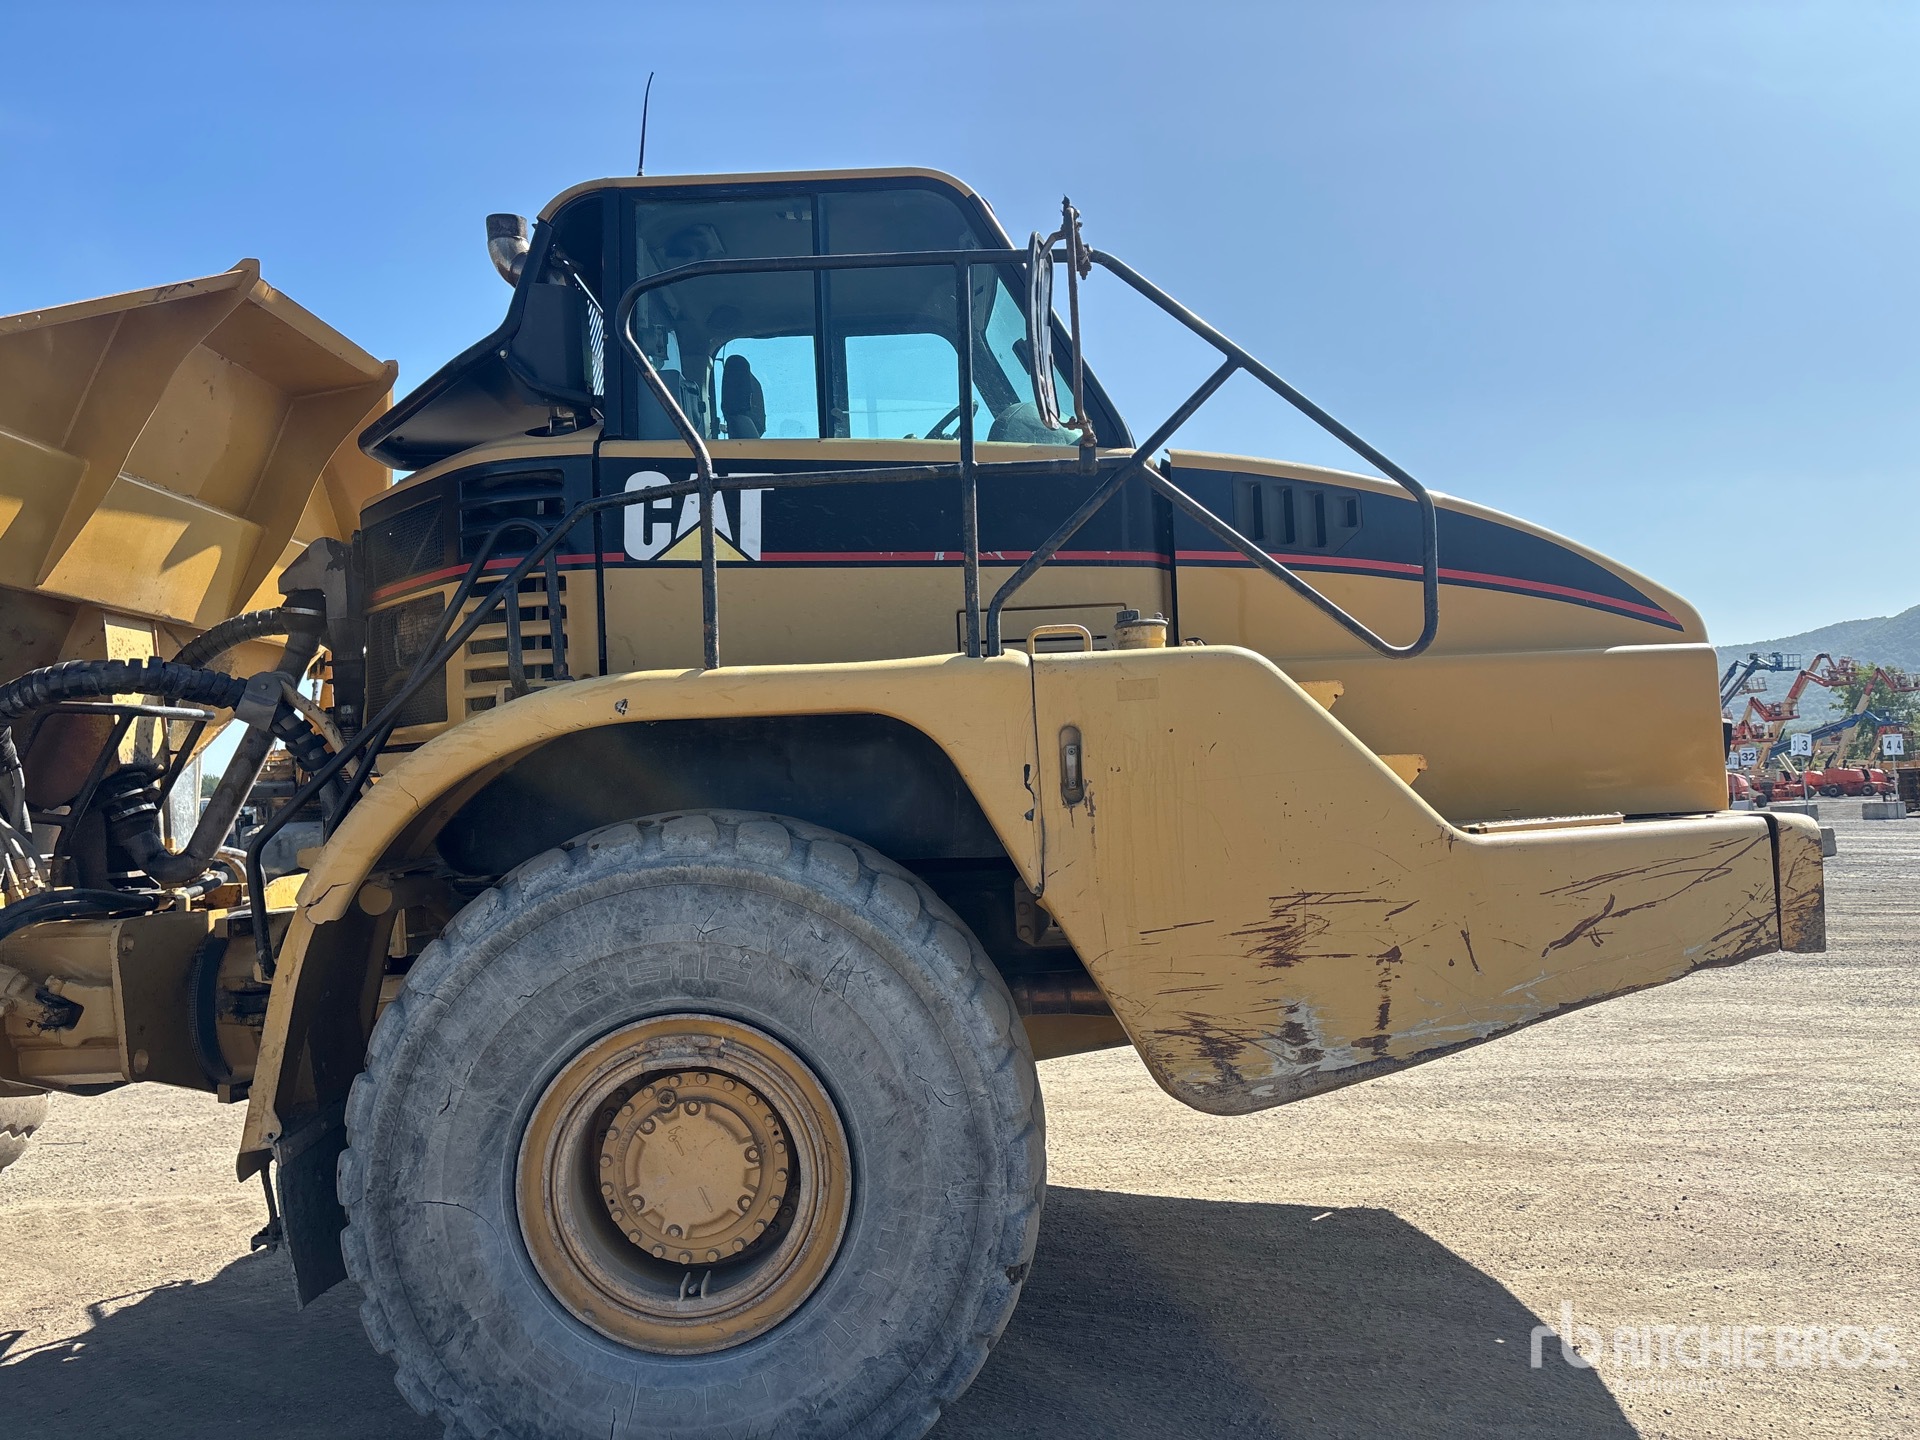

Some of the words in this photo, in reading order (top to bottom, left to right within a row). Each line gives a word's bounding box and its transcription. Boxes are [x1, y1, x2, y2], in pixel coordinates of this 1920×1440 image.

[624, 471, 775, 561] CAT
[1802, 740, 1808, 751] 3
[1886, 740, 1892, 751] 4
[1896, 740, 1902, 751] 4
[1741, 752, 1755, 761] 32
[523, 1213, 909, 1417] TRIANGLE
